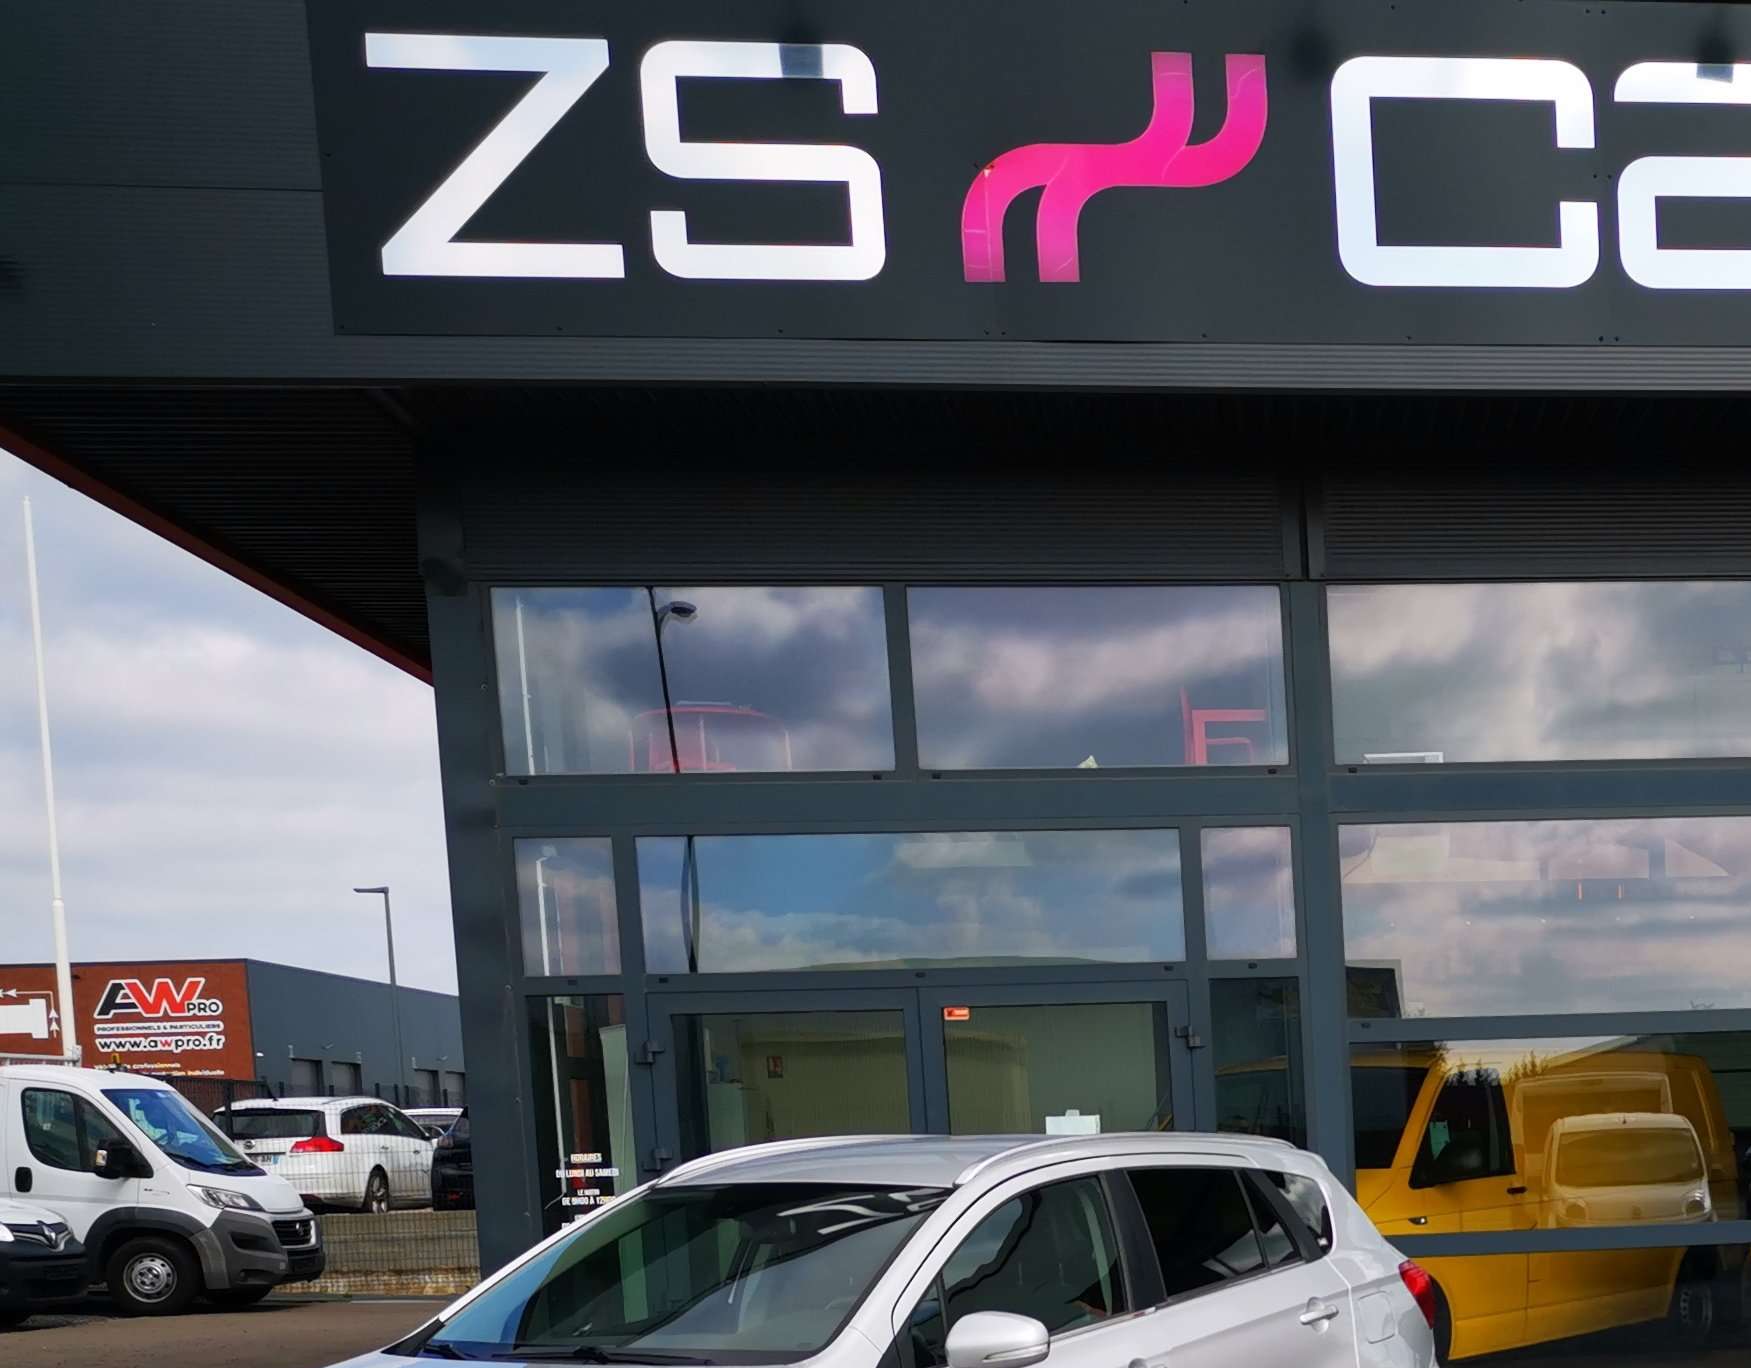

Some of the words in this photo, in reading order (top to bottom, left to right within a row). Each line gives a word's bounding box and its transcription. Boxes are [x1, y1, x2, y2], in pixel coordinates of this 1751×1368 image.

[364, 33, 886, 280] ZS
[95, 978, 203, 1018] AW
[186, 1000, 221, 1014] PRO
[98, 1035, 222, 1050] www.awpro.fr
